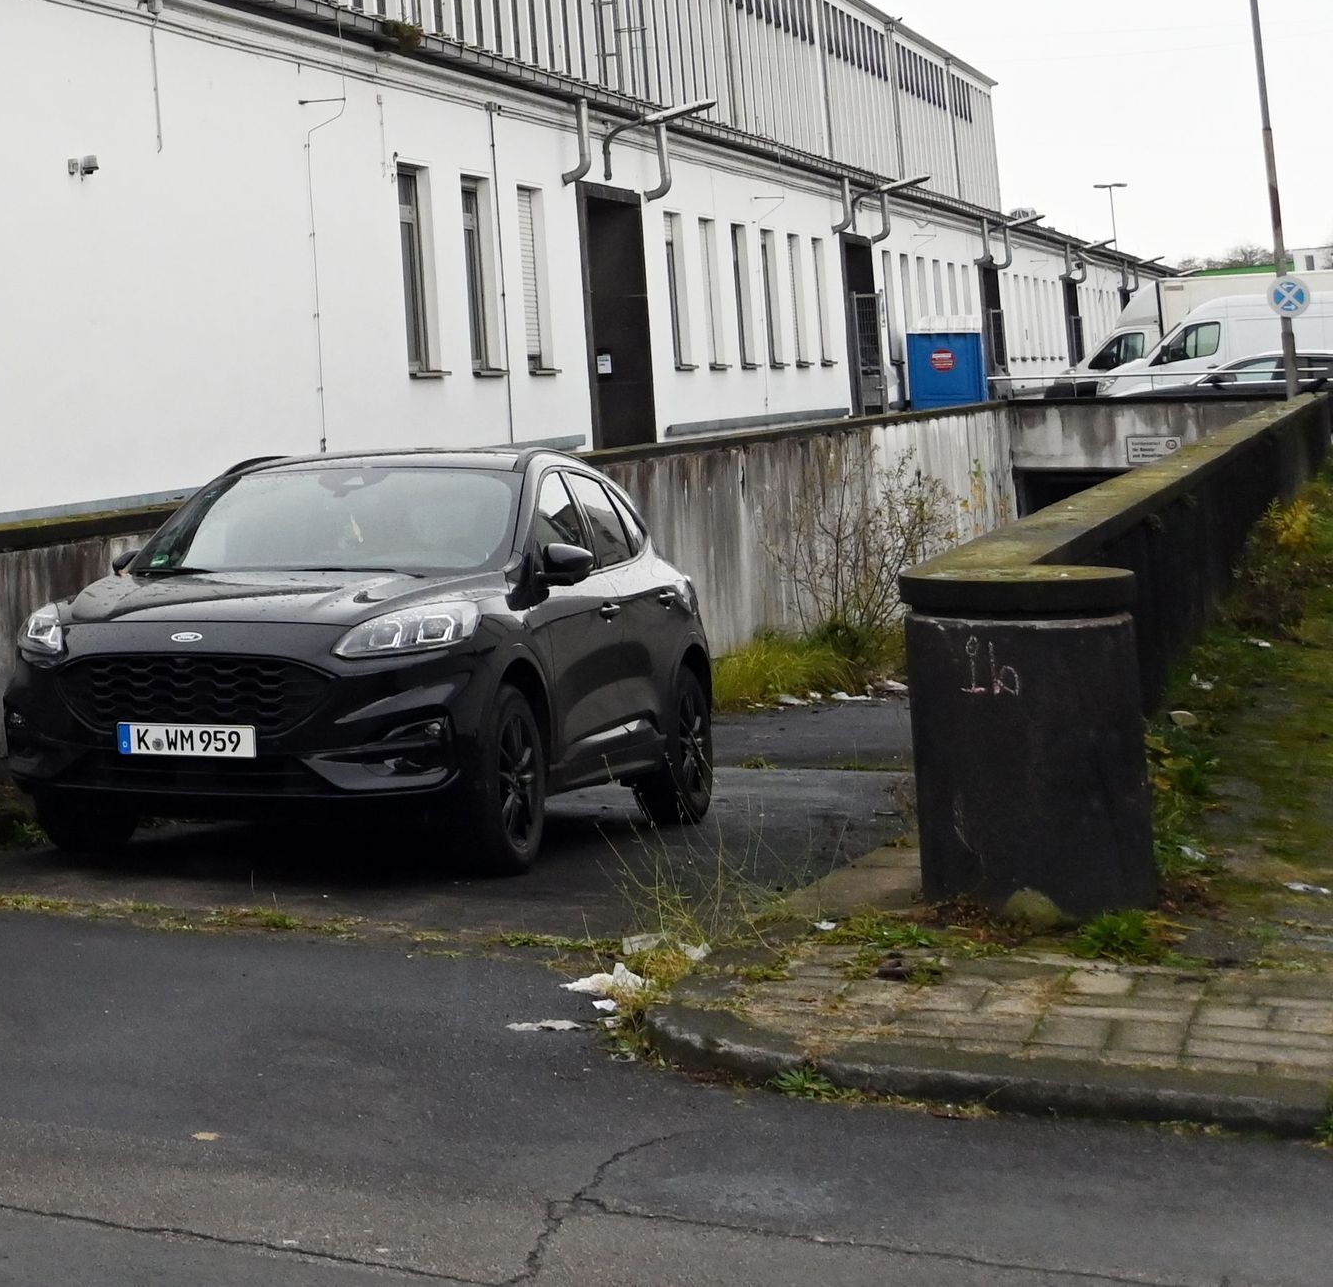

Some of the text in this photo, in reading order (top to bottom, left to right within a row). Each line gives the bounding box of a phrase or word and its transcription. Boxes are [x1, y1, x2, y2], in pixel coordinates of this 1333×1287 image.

[136, 728, 151, 751] K
[165, 728, 195, 752] WM
[199, 730, 241, 753] 959
